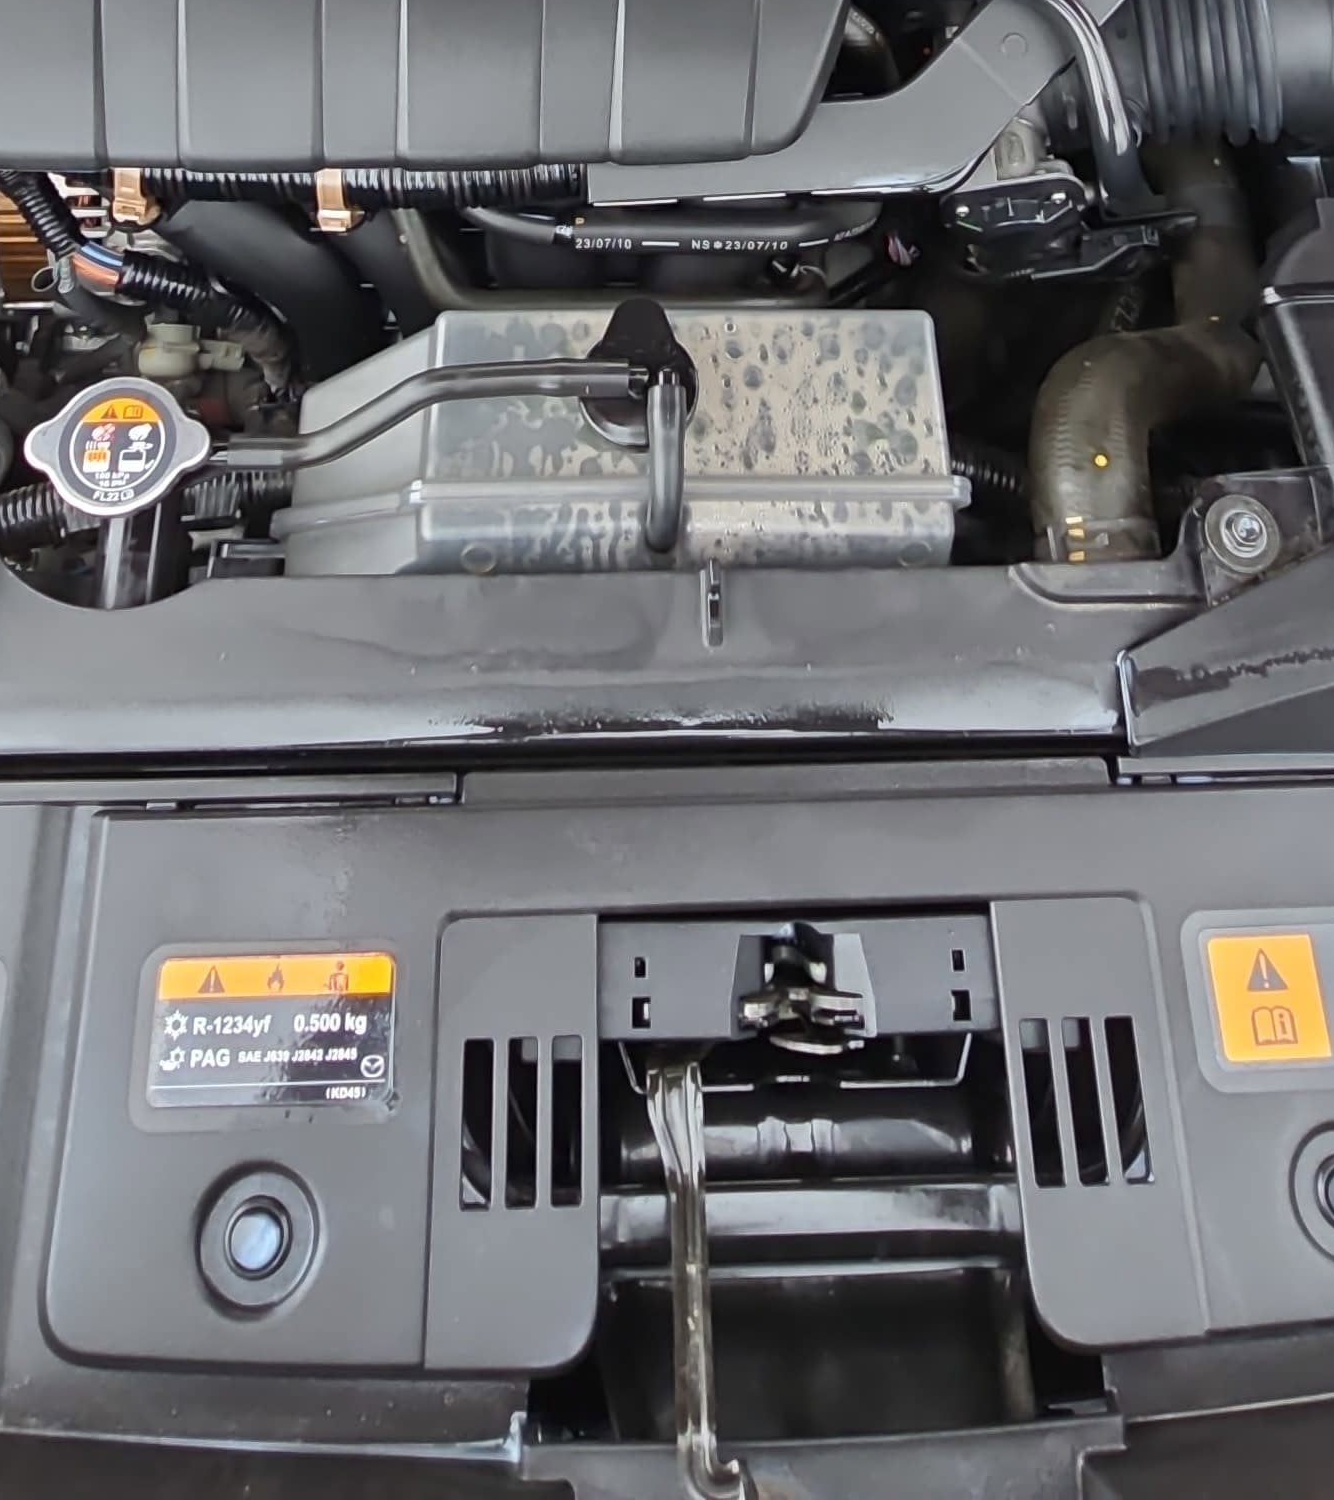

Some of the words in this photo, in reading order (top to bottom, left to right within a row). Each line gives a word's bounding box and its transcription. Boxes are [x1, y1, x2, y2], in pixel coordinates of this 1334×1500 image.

[575, 237, 632, 250] 23/07/10
[92, 490, 120, 502] FL22
[193, 1014, 271, 1037] R-1234yf
[294, 1014, 341, 1032] 0.500
[344, 1012, 367, 1035] kg
[190, 1049, 230, 1067] PAG
[238, 1051, 261, 1063] SAE
